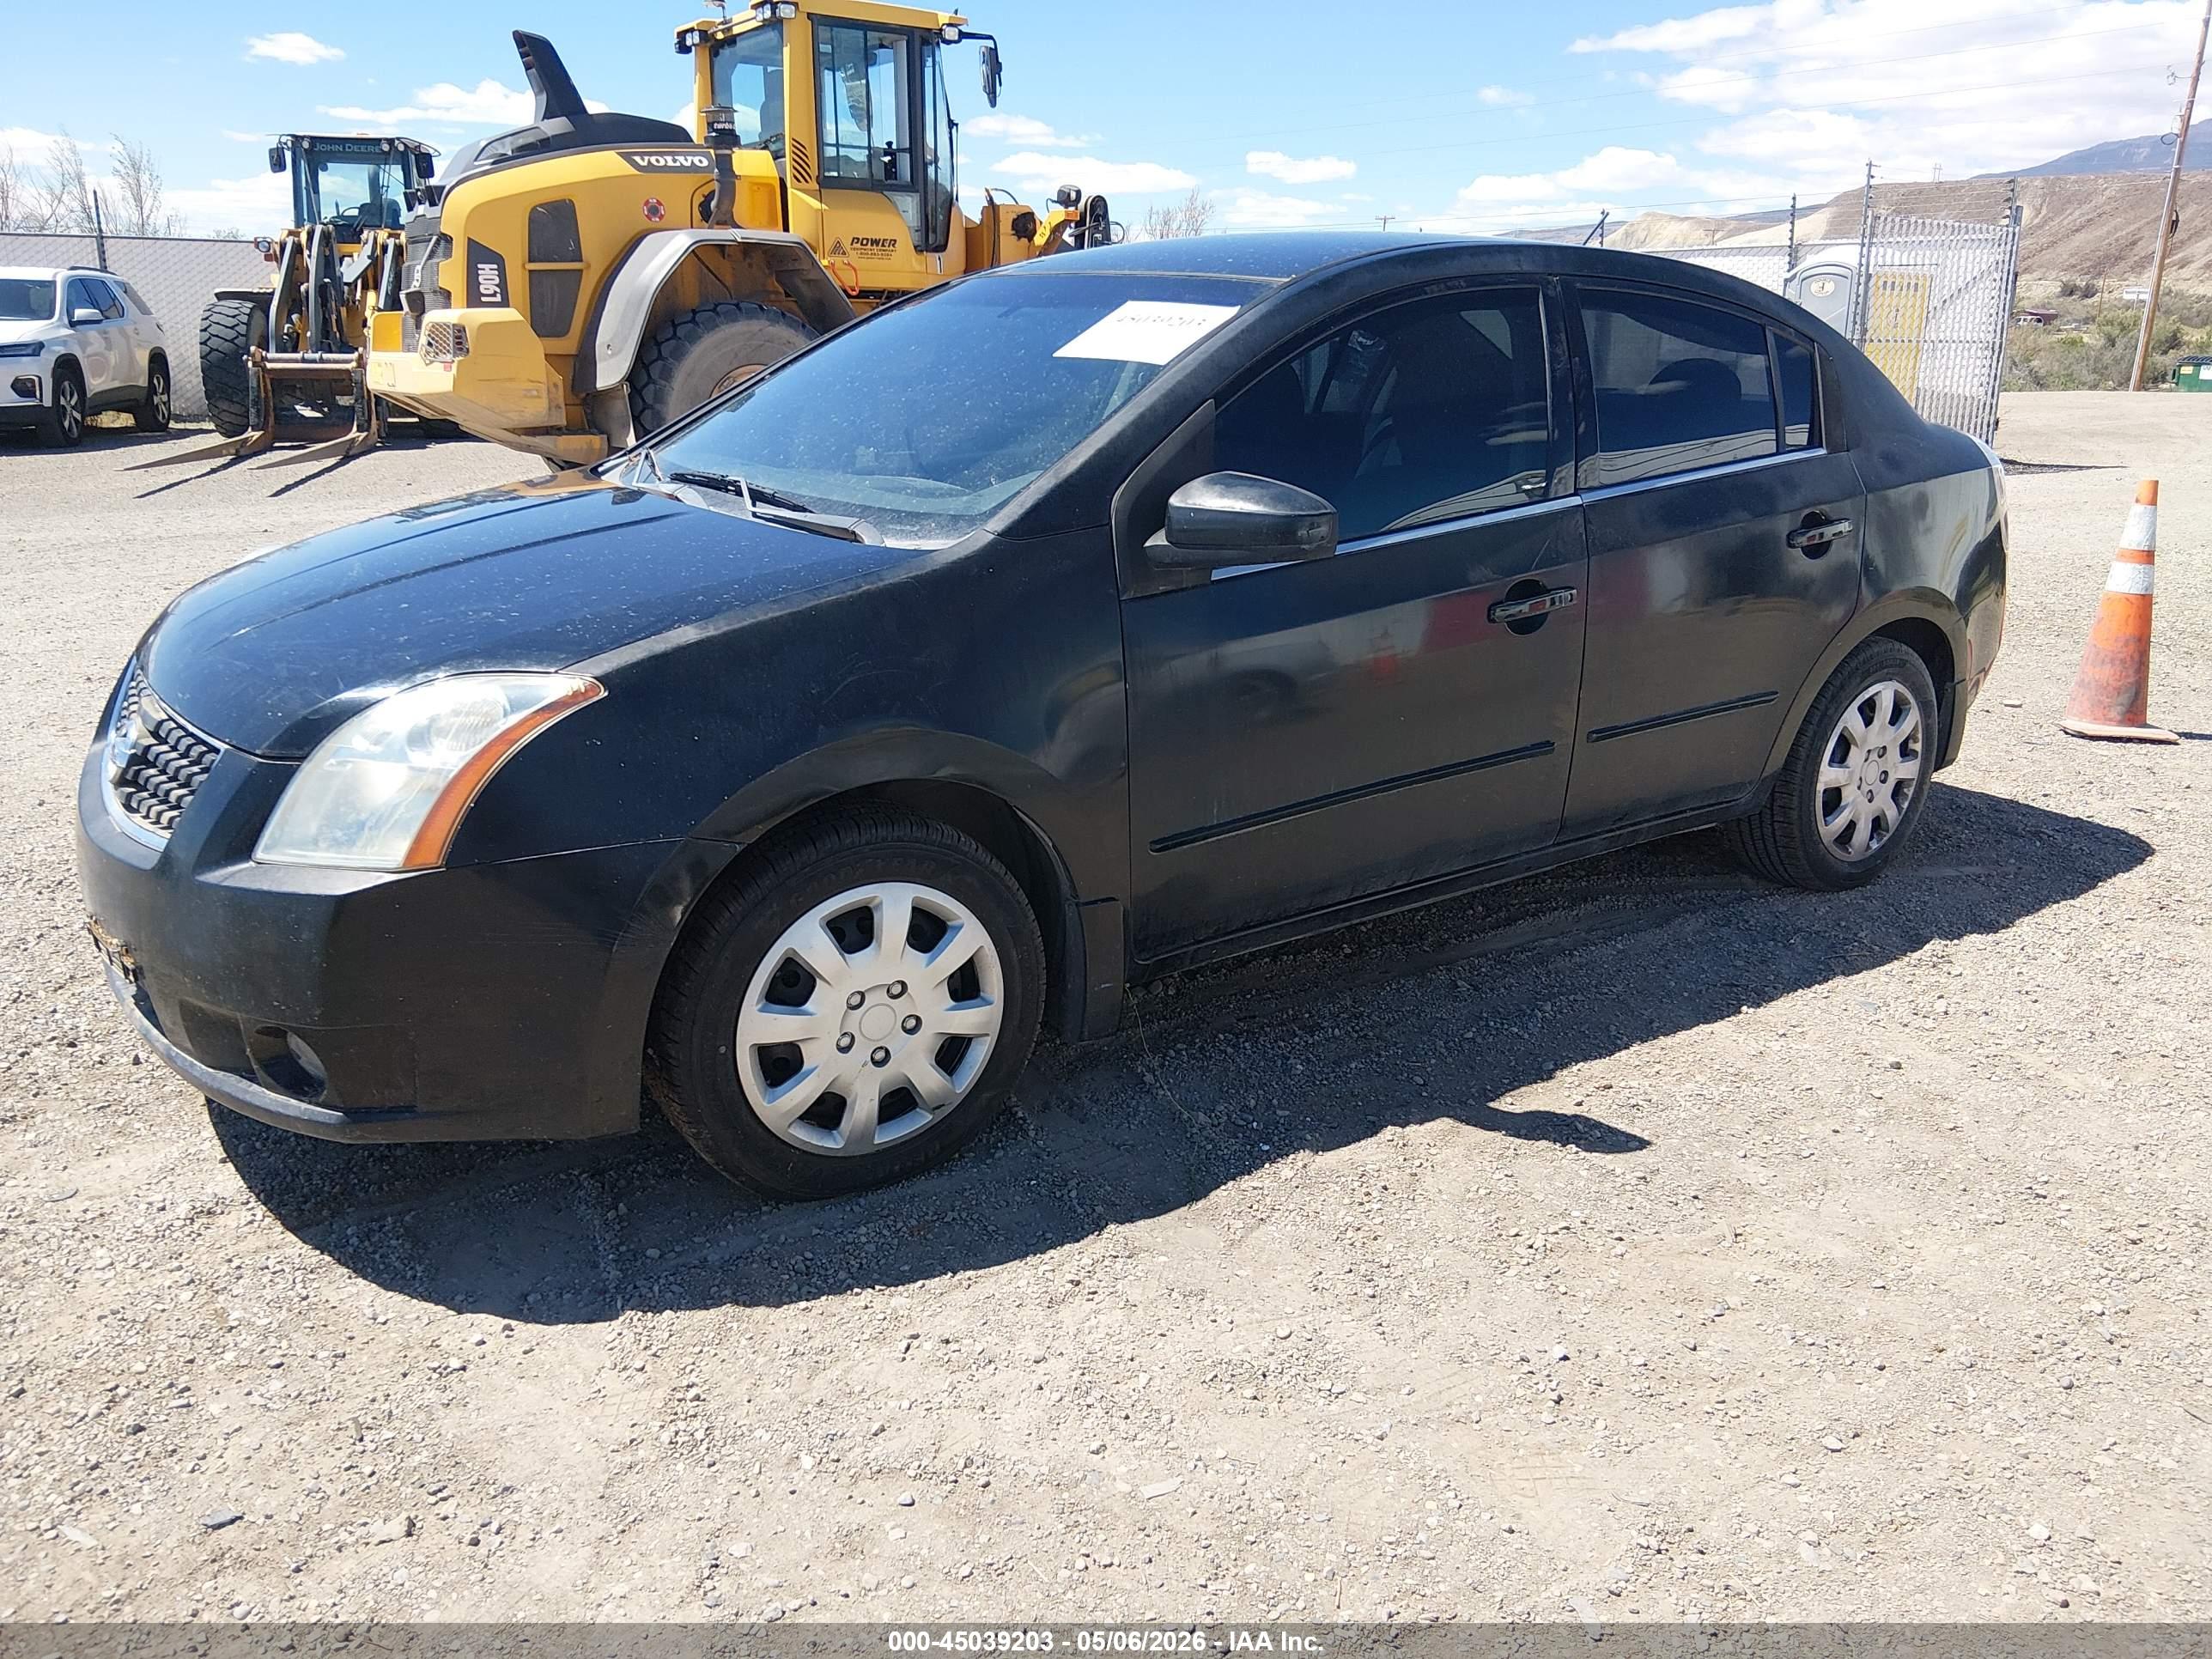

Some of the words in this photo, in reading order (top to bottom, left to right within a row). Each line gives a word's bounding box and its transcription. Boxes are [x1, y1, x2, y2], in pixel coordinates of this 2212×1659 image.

[313, 143, 343, 152] JOHN
[345, 143, 383, 153] DEERE
[631, 155, 709, 167] VOLVO
[850, 237, 897, 248] POWER
[477, 263, 502, 302] L90H
